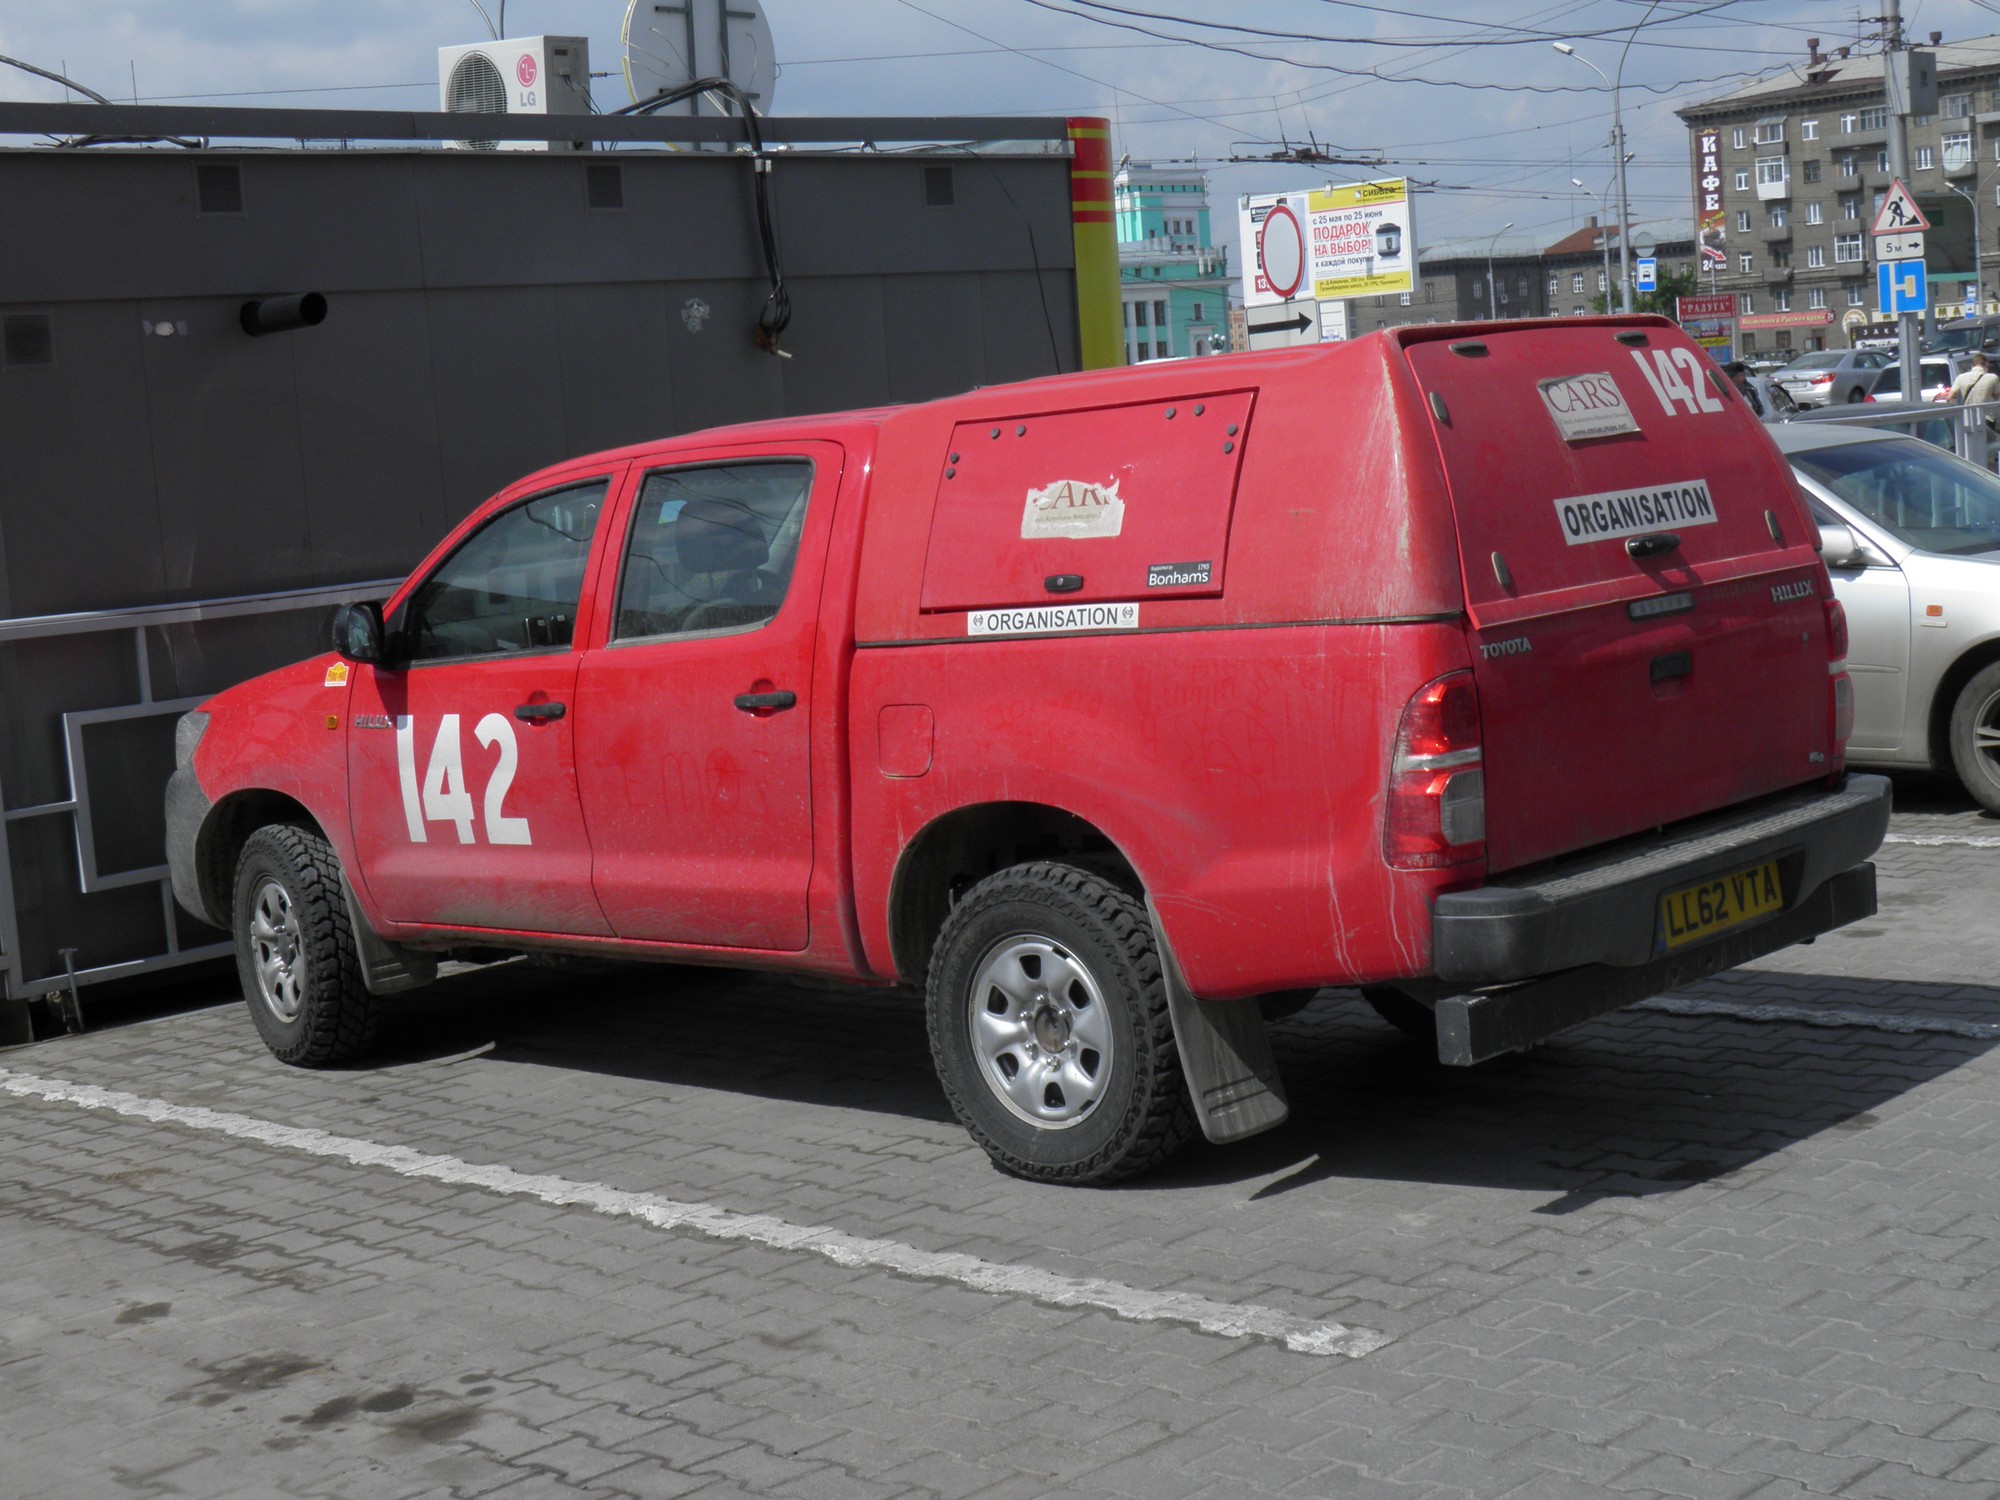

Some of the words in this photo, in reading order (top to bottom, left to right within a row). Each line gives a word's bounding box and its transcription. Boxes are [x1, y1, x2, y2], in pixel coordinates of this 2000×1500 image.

[520, 91, 536, 107] LG
[1702, 135, 1720, 211] КАФЕ
[1318, 215, 1327, 224] 25
[1329, 215, 1342, 223] мая
[1353, 210, 1363, 220] 25
[1364, 210, 1383, 219] июня
[1313, 221, 1371, 241] ПОДАРОК
[1314, 243, 1328, 256] НА
[1330, 239, 1371, 255] ВЫБОР!
[1886, 242, 1893, 253] 5
[1321, 257, 1345, 267] каждой
[1347, 255, 1374, 265] покупке
[1630, 347, 1724, 416] 142
[1544, 377, 1620, 413] CARS
[1564, 486, 1711, 537] ORGANISATION
[1148, 571, 1209, 586] Bonhams
[1770, 579, 1814, 603] HILUX
[987, 607, 1118, 631] ORGANISATION
[1480, 637, 1532, 660] TOYOTA
[396, 712, 532, 845] 142
[1667, 882, 1729, 937] LL62
[1731, 865, 1778, 913] VTA
